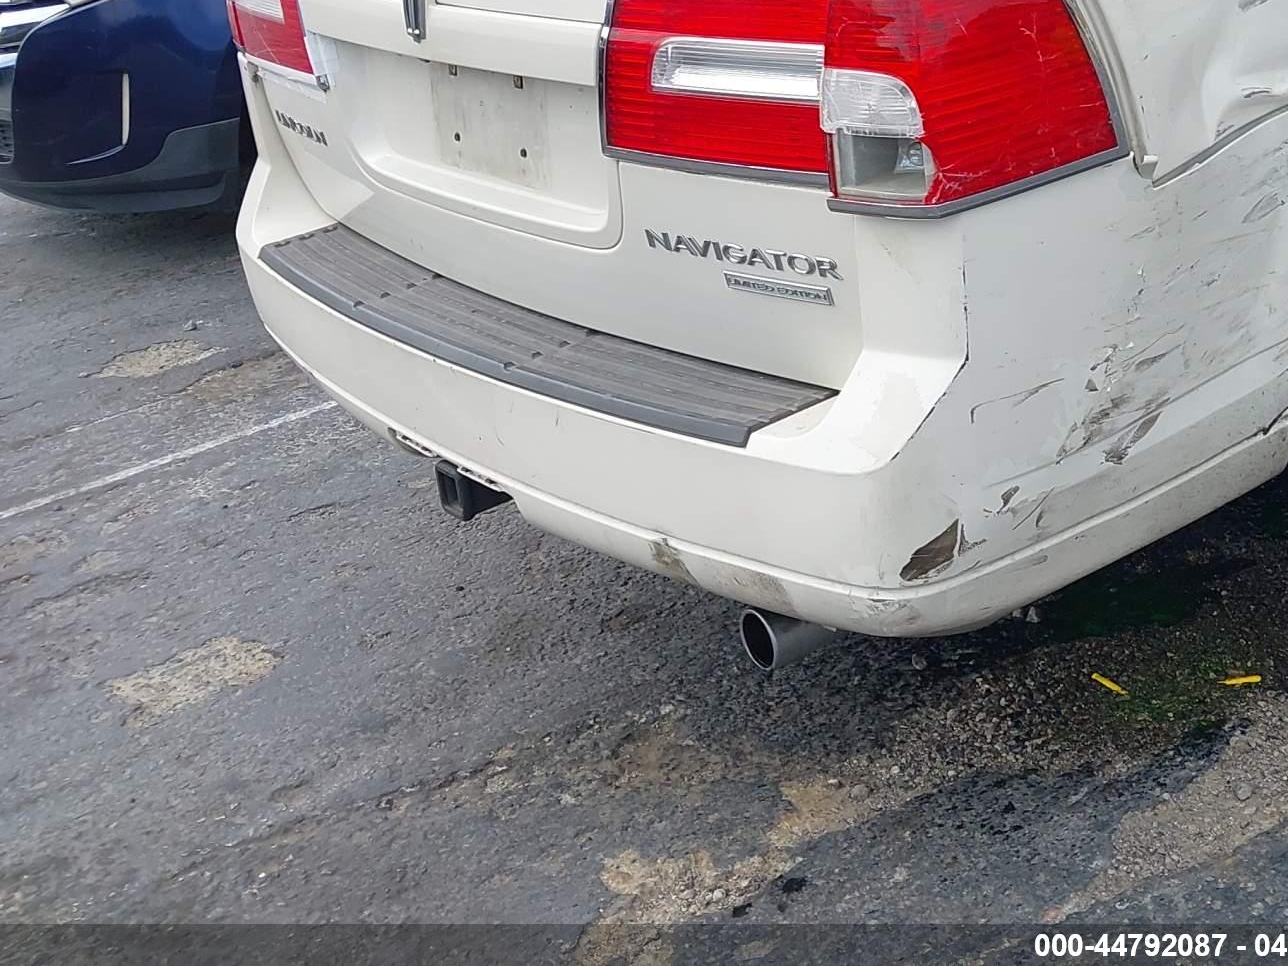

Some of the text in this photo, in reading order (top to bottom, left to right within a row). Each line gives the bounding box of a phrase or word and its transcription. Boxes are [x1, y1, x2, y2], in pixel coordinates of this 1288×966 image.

[644, 229, 844, 280] NAVIGATOR
[727, 277, 827, 301] LIMITED EDITION
